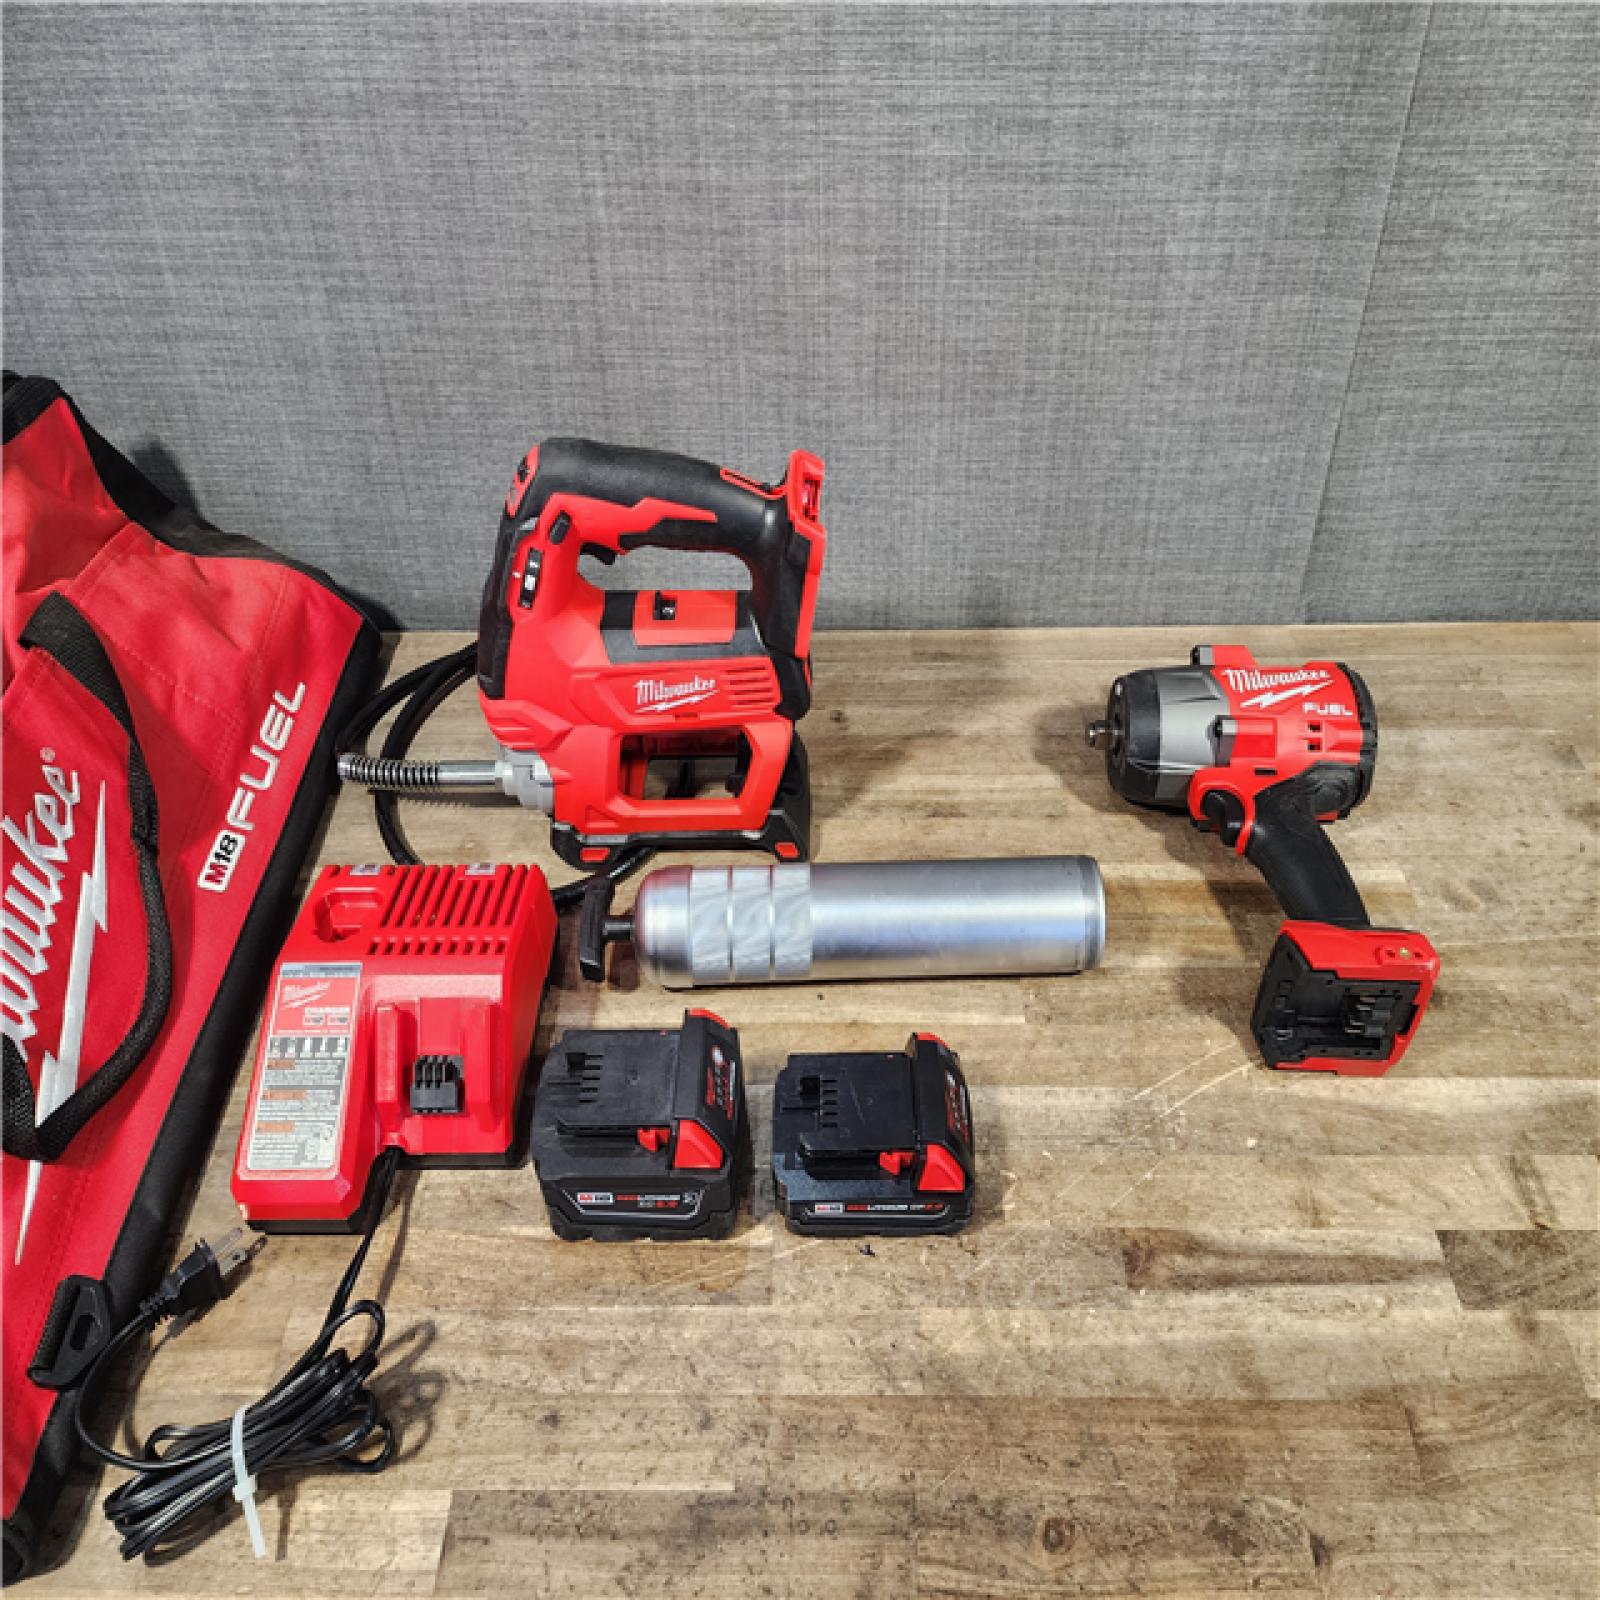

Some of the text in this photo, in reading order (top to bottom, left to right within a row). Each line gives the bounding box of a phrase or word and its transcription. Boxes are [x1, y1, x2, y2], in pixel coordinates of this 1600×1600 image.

[633, 674, 716, 706] Milwaukee
[1221, 669, 1331, 693] Milwaukee
[1302, 702, 1353, 716] FUEL
[204, 682, 306, 884] M18 FUEL
